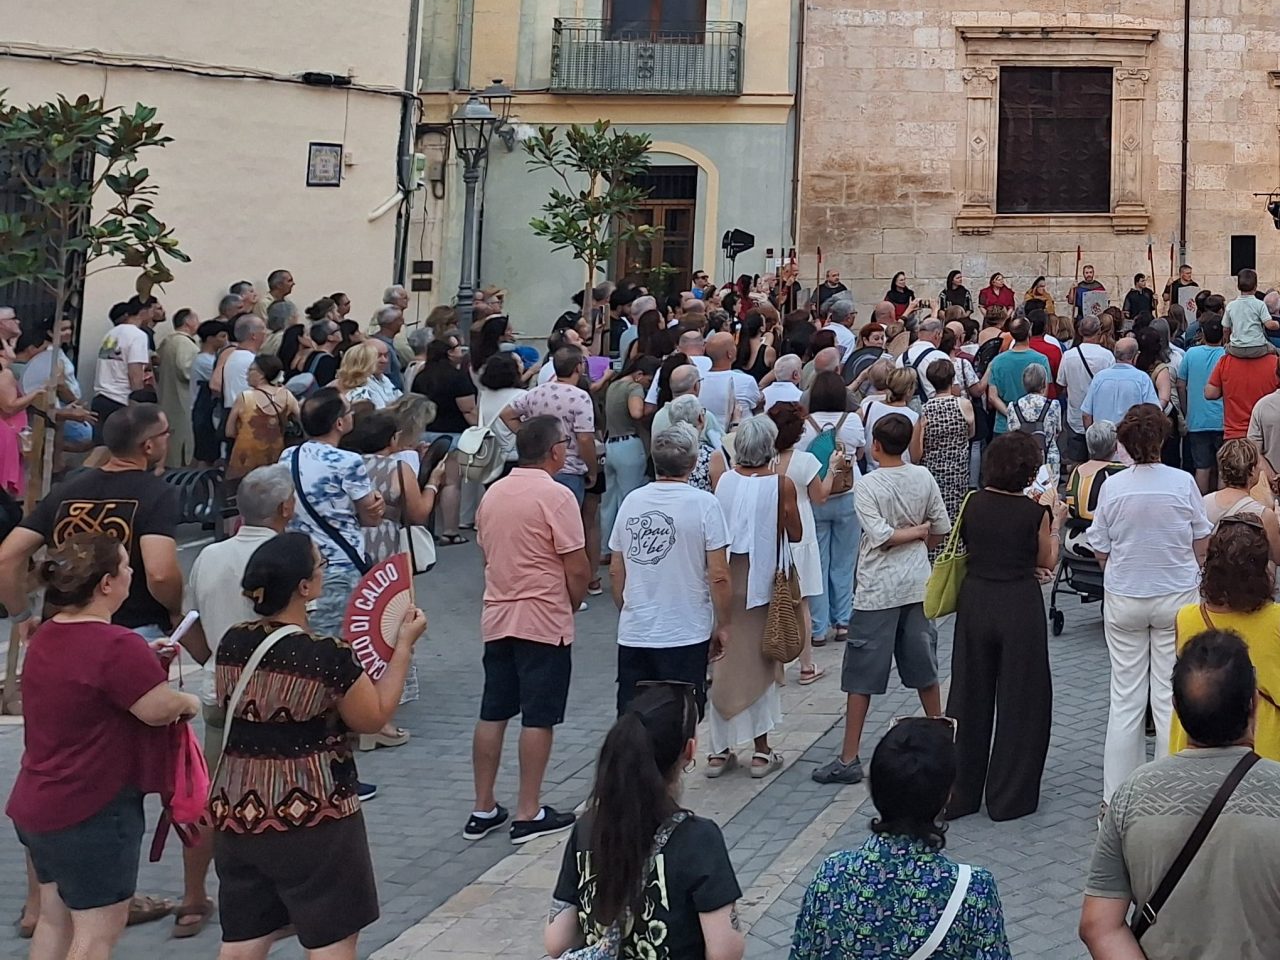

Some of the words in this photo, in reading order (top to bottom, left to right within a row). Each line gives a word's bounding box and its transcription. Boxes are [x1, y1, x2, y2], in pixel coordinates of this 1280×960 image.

[640, 527, 670, 540] pau
[354, 562, 399, 611] CALDO
[349, 615, 370, 633] DI
[352, 635, 388, 681] CAZZO
